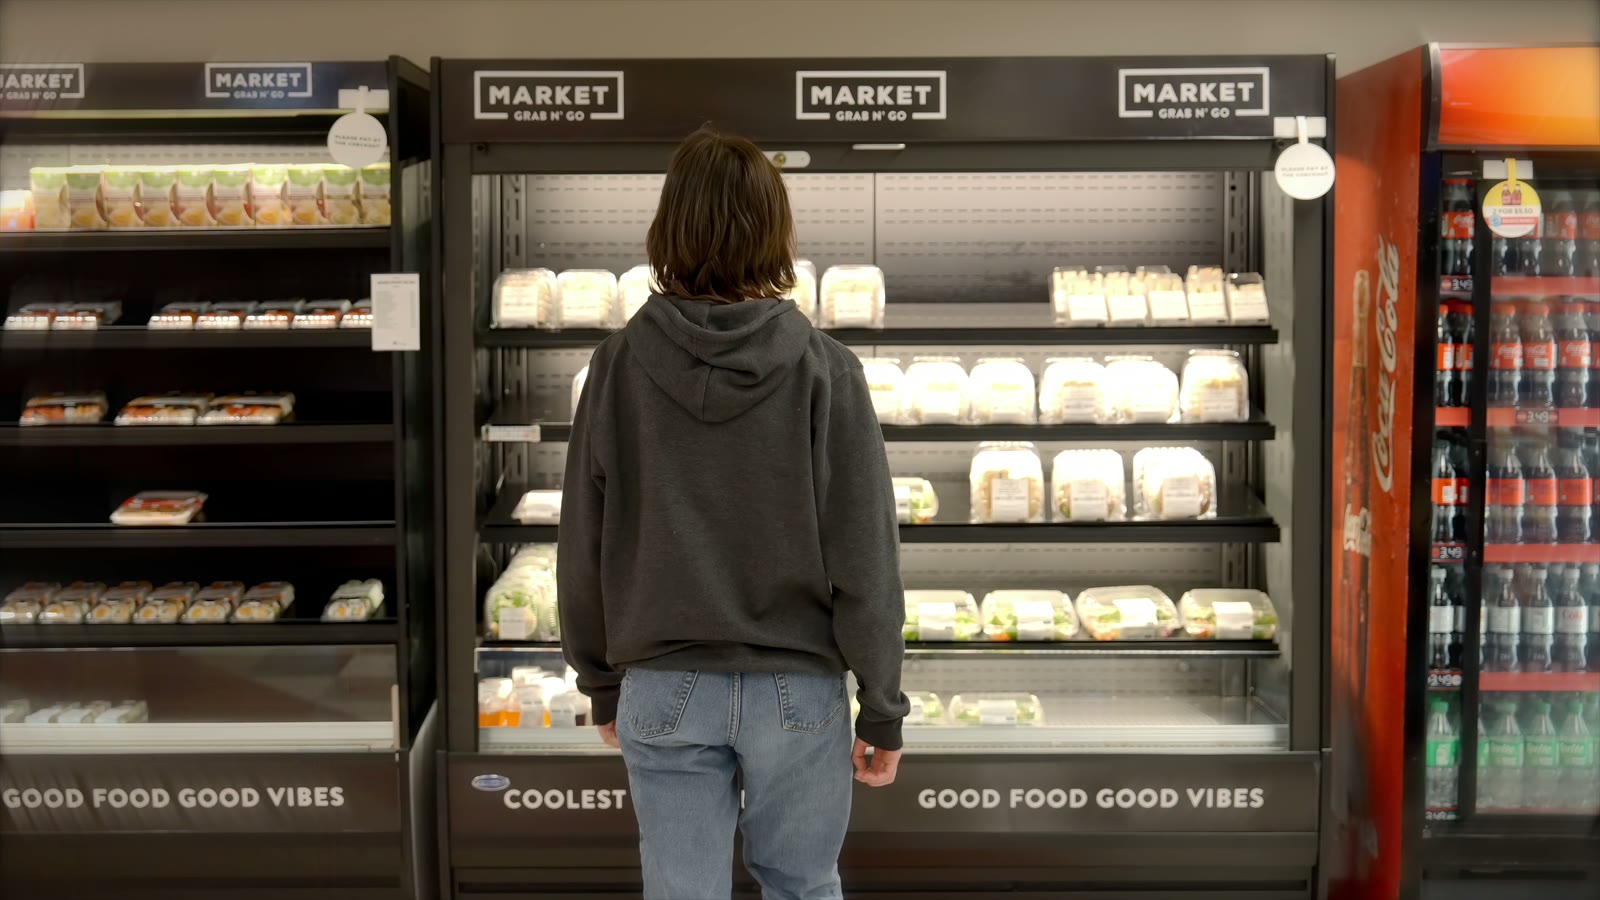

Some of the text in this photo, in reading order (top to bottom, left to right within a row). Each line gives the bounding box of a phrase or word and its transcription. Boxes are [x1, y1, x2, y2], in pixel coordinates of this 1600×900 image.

[215, 72, 302, 88] MARKET
[6, 91, 31, 101] GRAB
[42, 91, 57, 101] GO
[233, 90, 258, 99] GRAB
[270, 90, 285, 99] GO
[488, 85, 610, 106] MARKET
[810, 85, 932, 106] MARKET
[1133, 81, 1255, 104] MARKET
[513, 110, 548, 122] GRAB
[565, 110, 585, 122] GO
[835, 110, 870, 122] GRAB
[887, 110, 907, 122] GO
[1158, 107, 1193, 119] GRAB
[1210, 107, 1231, 119] GO
[2, 786, 345, 809] GOOD FOOD GOOD VIBES
[503, 788, 627, 810] COOLEST
[918, 787, 1265, 809] GOOD FOOD GOOD VIBES
